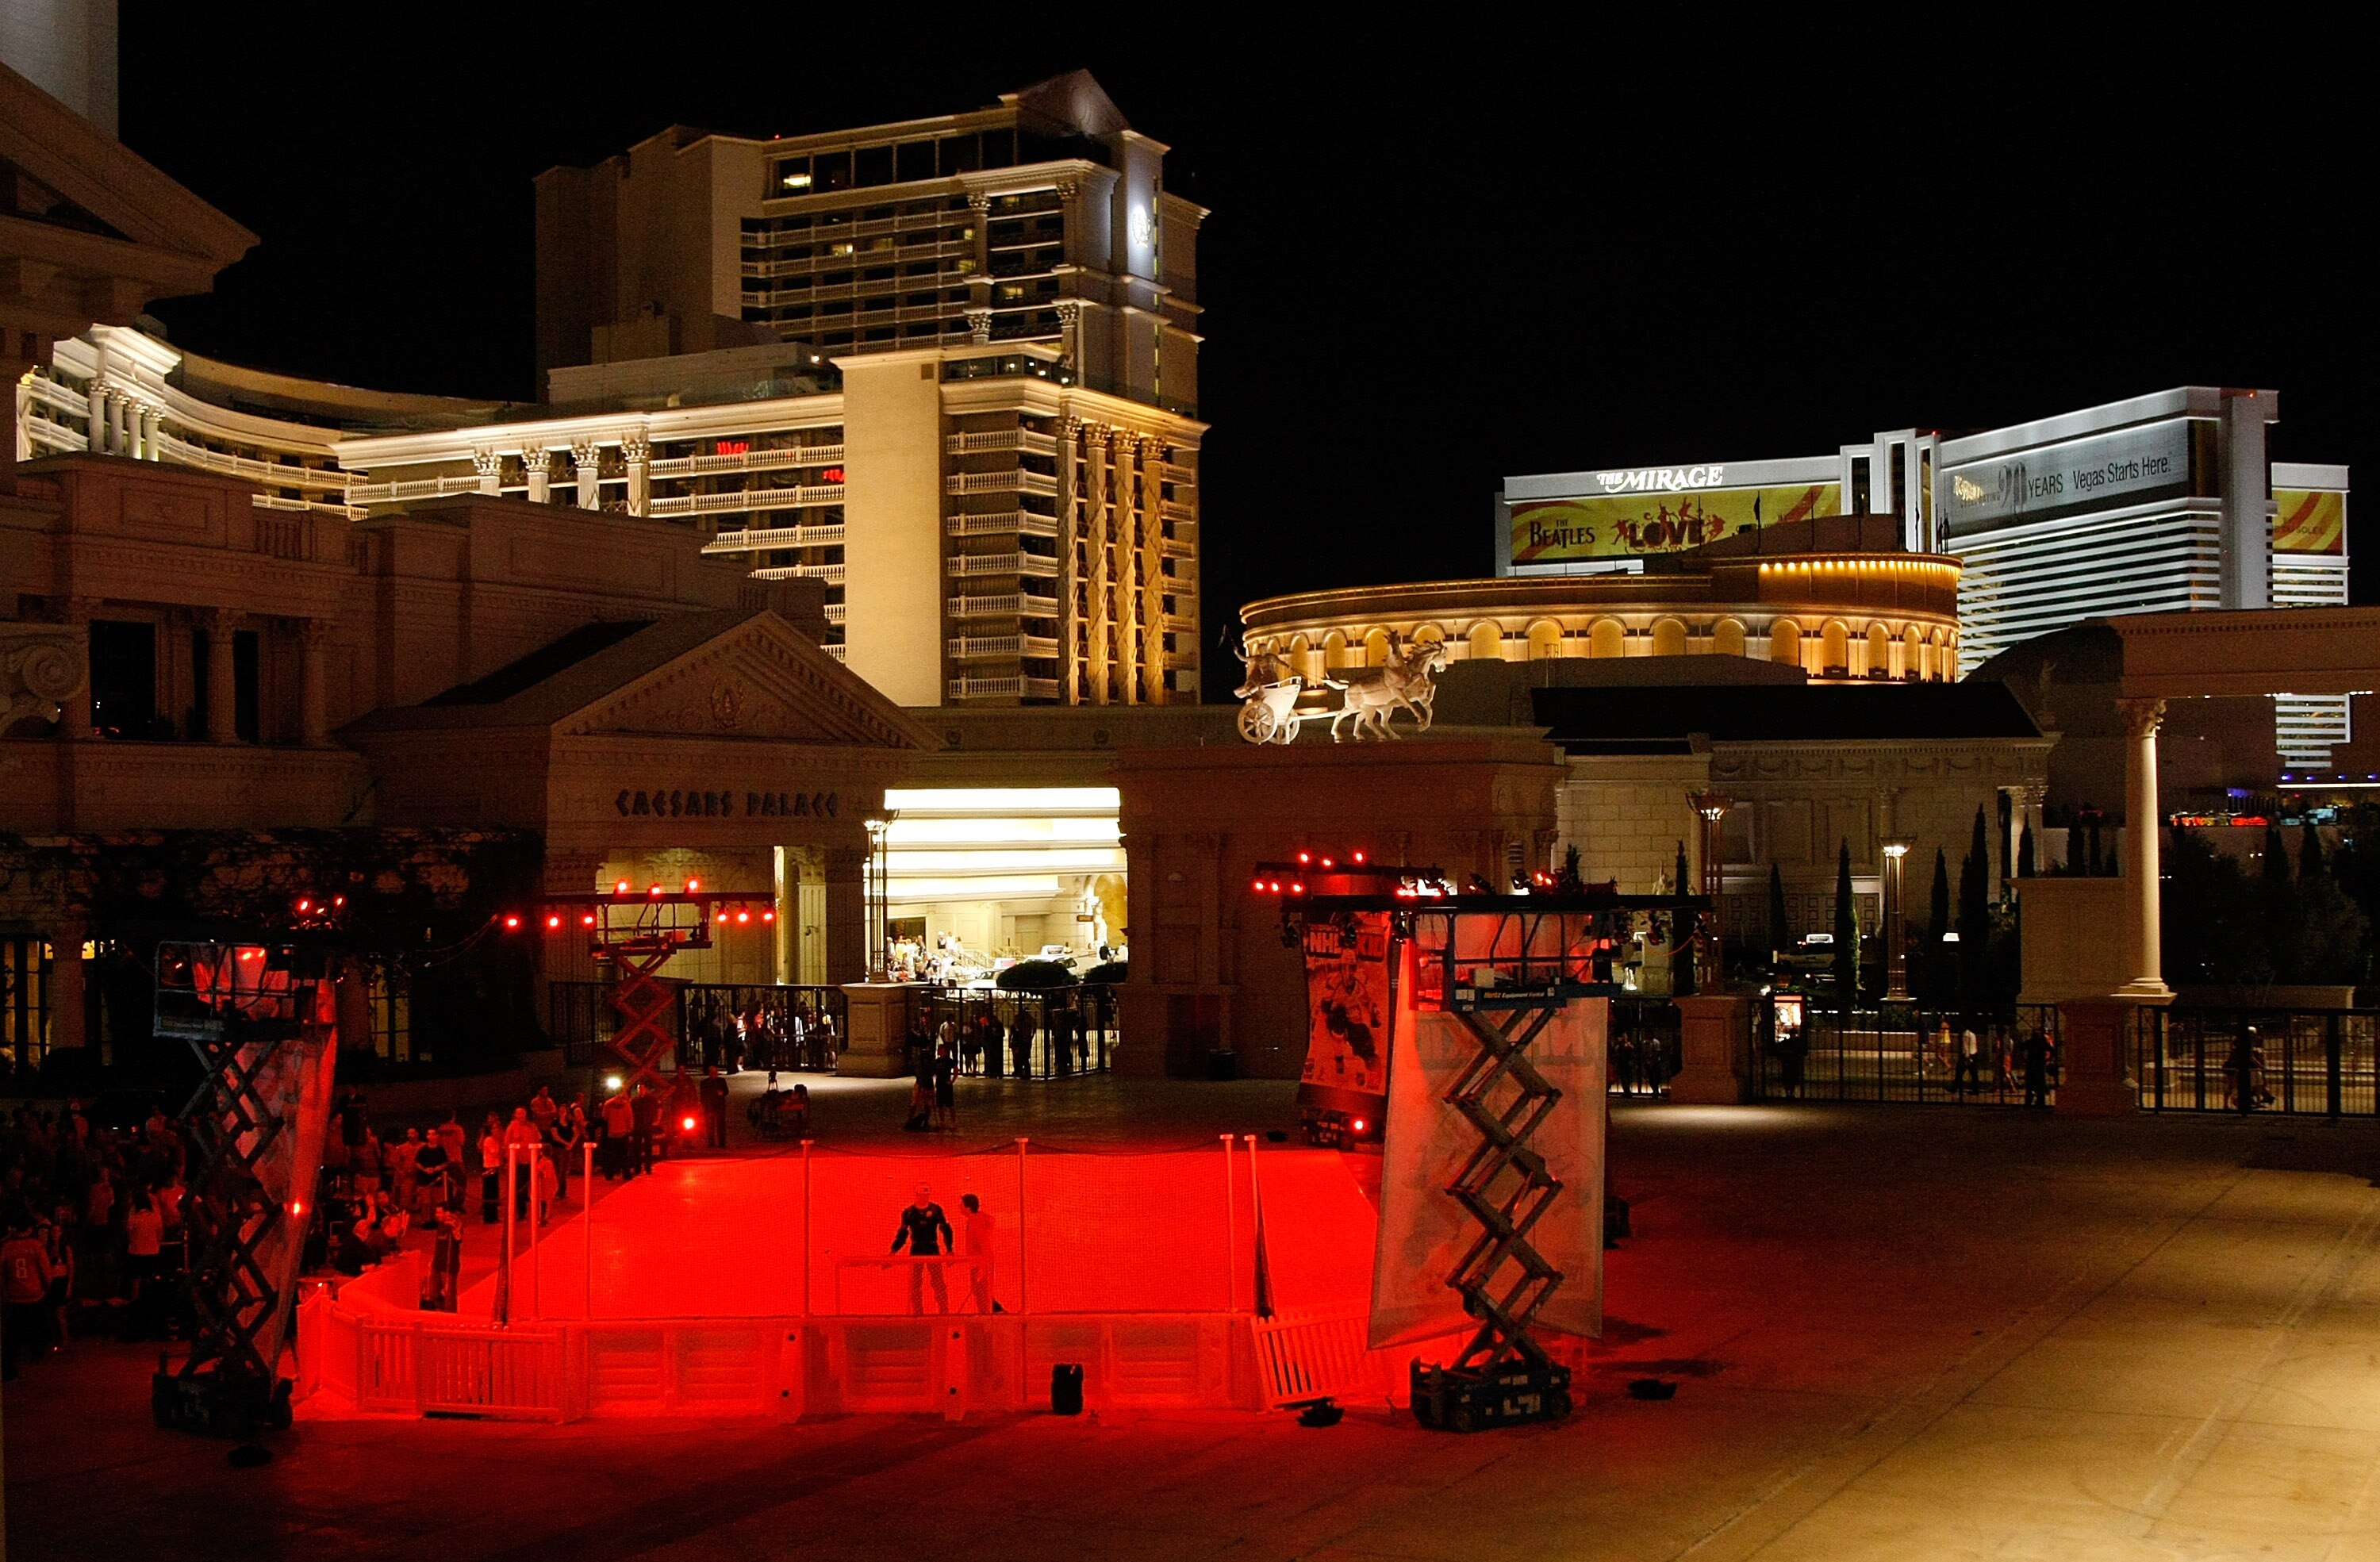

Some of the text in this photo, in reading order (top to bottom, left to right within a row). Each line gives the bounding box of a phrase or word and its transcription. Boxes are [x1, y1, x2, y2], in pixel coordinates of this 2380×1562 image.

[1596, 466, 1723, 493] THE MIRAGE
[2028, 474, 2063, 497] YEARS
[2072, 470, 2106, 492] Vegas
[2107, 460, 2140, 483] Starts
[2142, 456, 2171, 476] Here.
[1530, 520, 1595, 548] BEATLES
[1627, 519, 1706, 548] LOVE
[615, 789, 839, 817] CAESARS PALACE
[1309, 931, 1342, 954] NHL
